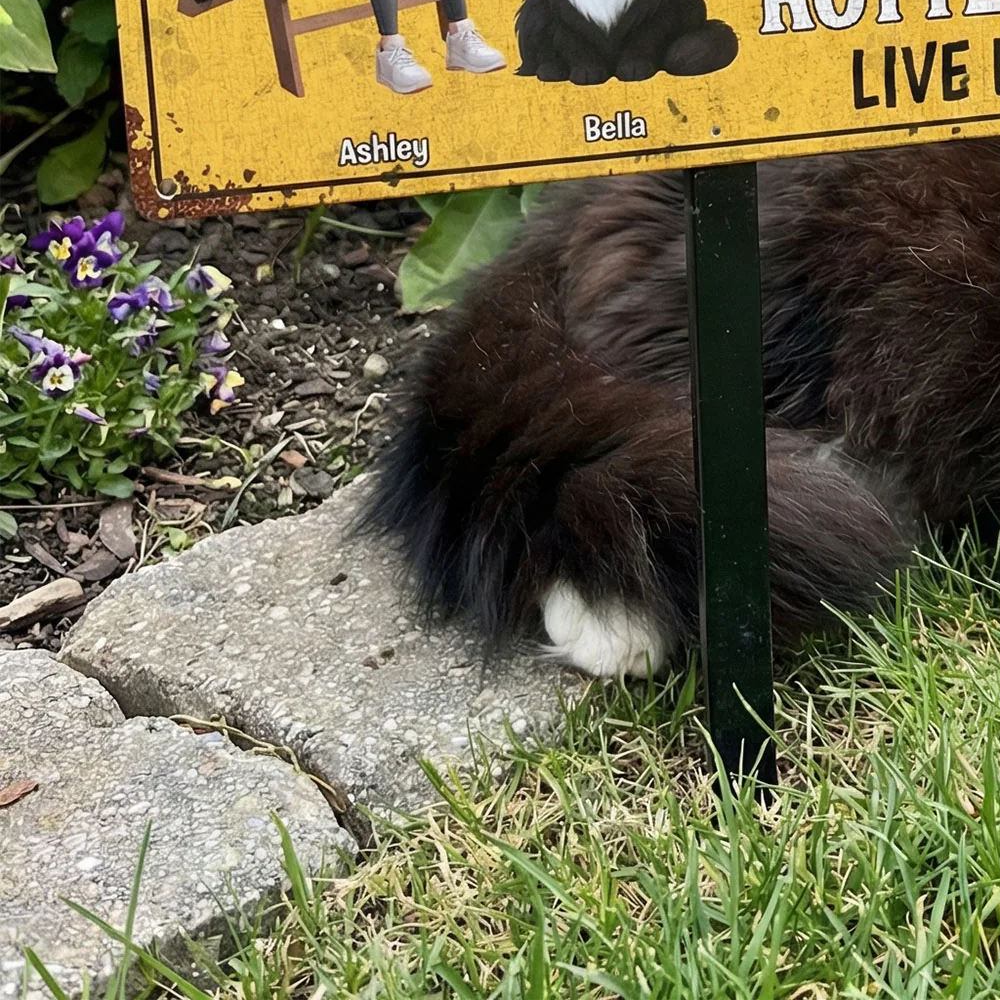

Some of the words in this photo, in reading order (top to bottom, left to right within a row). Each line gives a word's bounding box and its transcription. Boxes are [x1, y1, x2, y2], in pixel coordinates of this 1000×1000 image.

[852, 40, 970, 109] LIVE
[583, 110, 648, 143] Bella
[338, 132, 430, 168] Ashley
